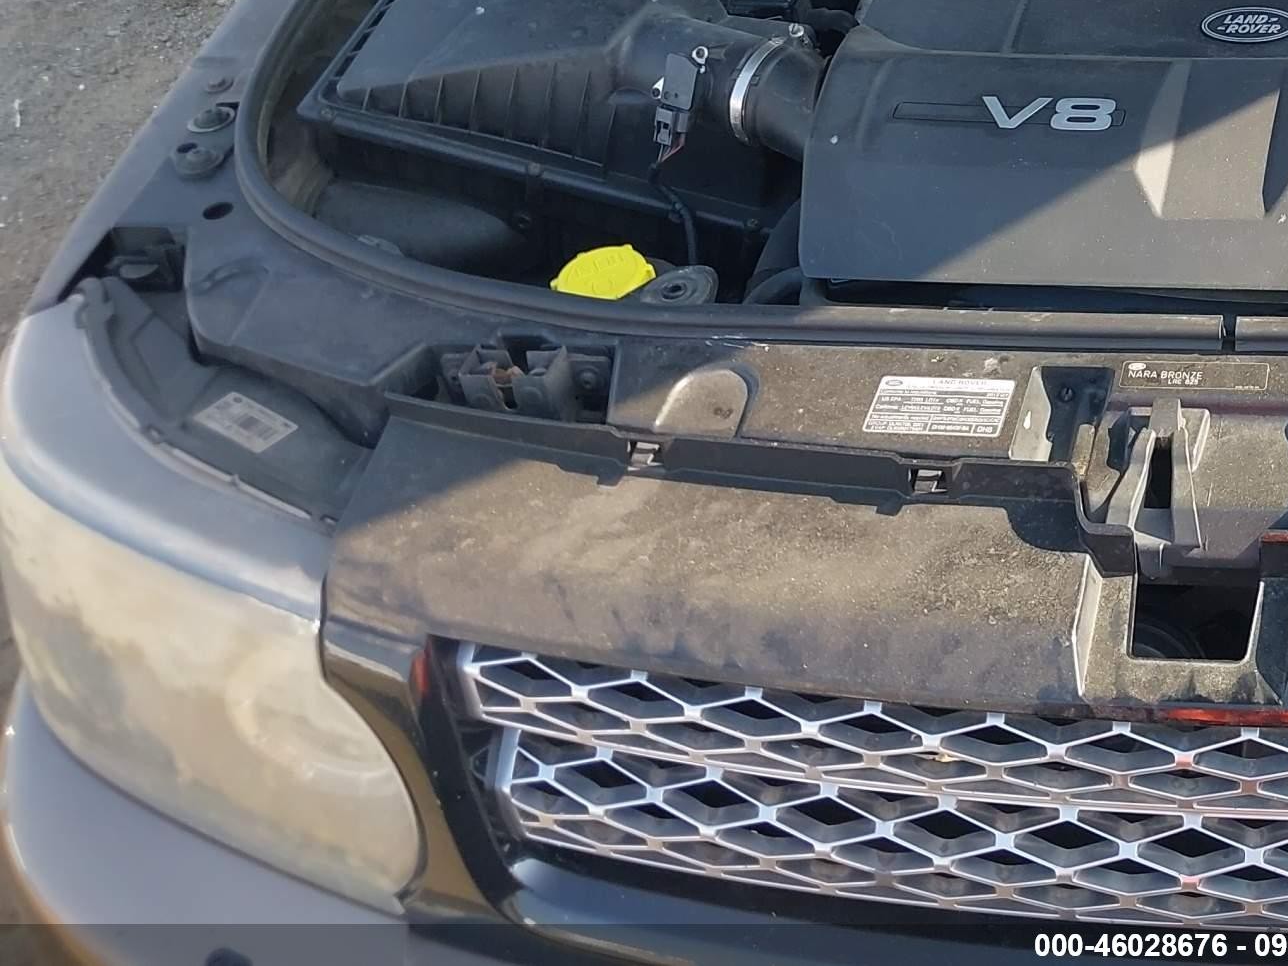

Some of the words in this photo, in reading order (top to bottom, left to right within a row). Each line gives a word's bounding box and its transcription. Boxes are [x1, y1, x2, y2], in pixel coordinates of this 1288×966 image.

[982, 95, 1121, 132] V8
[1128, 370, 1158, 379] NARA
[1160, 371, 1204, 380] BRONZE
